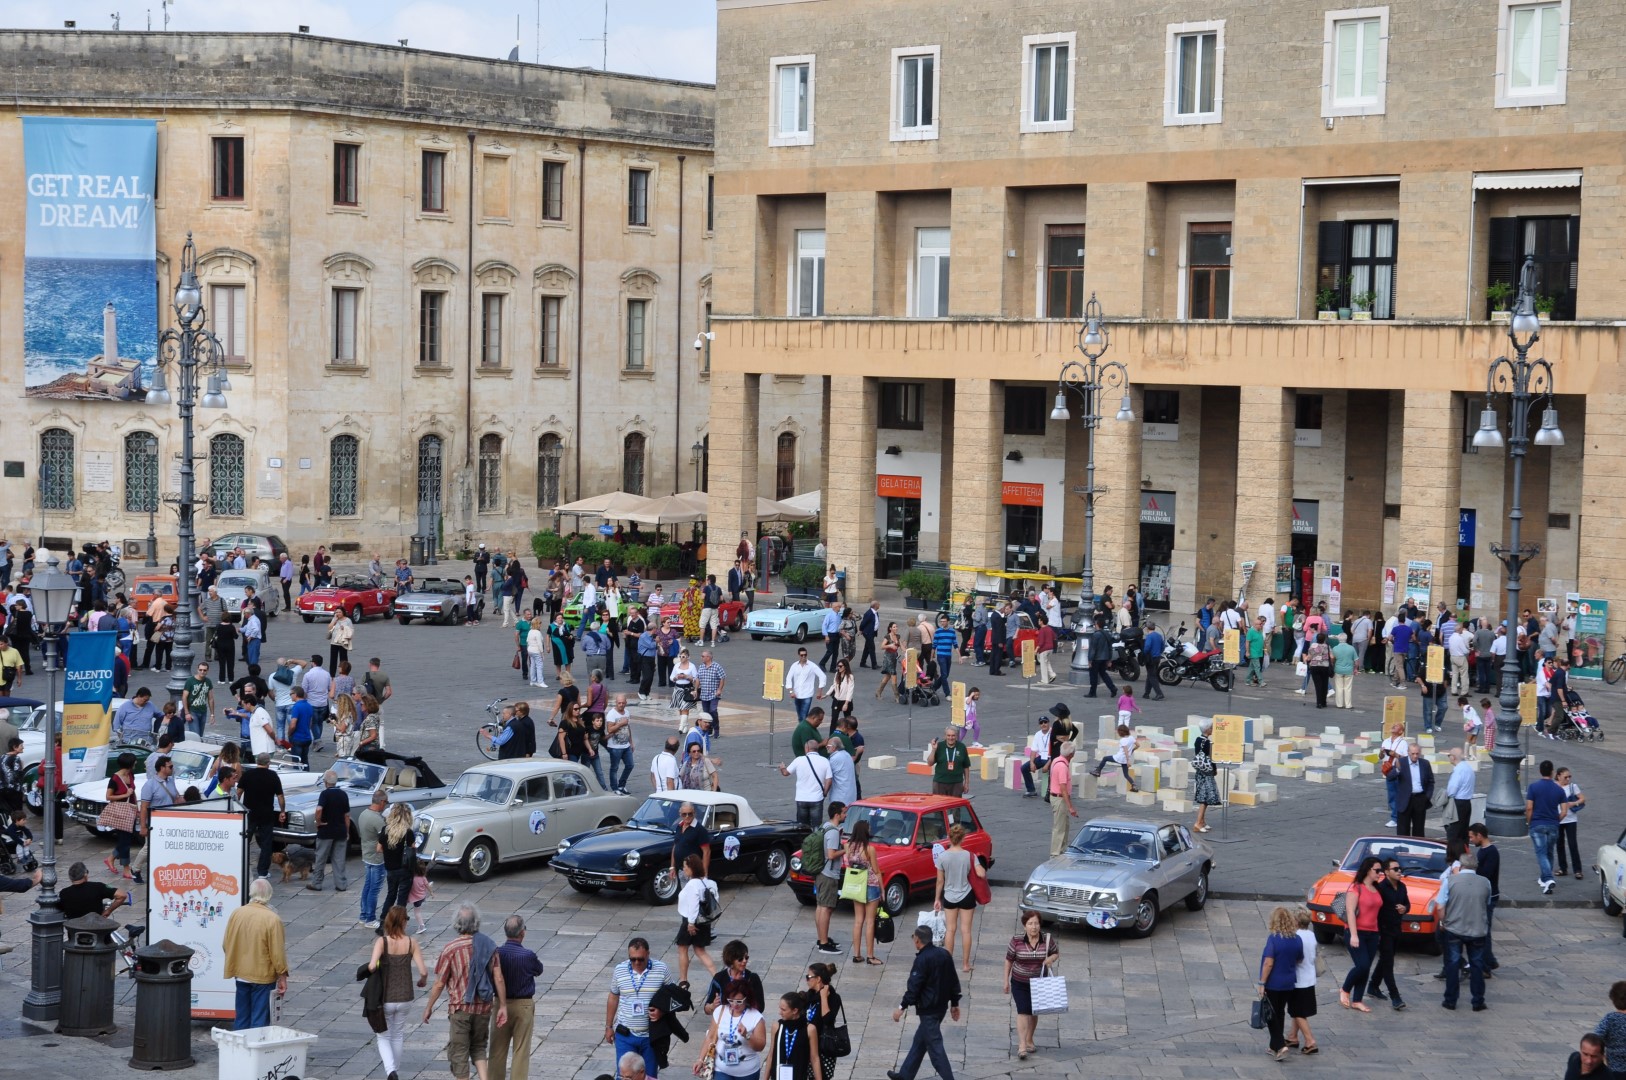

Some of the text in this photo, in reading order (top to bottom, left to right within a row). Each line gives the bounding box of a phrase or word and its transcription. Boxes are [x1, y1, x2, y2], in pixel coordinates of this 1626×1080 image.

[27, 173, 152, 204] GET REAL,
[39, 203, 139, 229] DREAM!
[880, 478, 921, 490] GELATERIA
[1002, 485, 1043, 497] AFFETTERIA
[1141, 509, 1167, 517] IBRERIA
[67, 669, 113, 681] SALENTO
[75, 679, 103, 694] 2019
[158, 828, 164, 837] 3.
